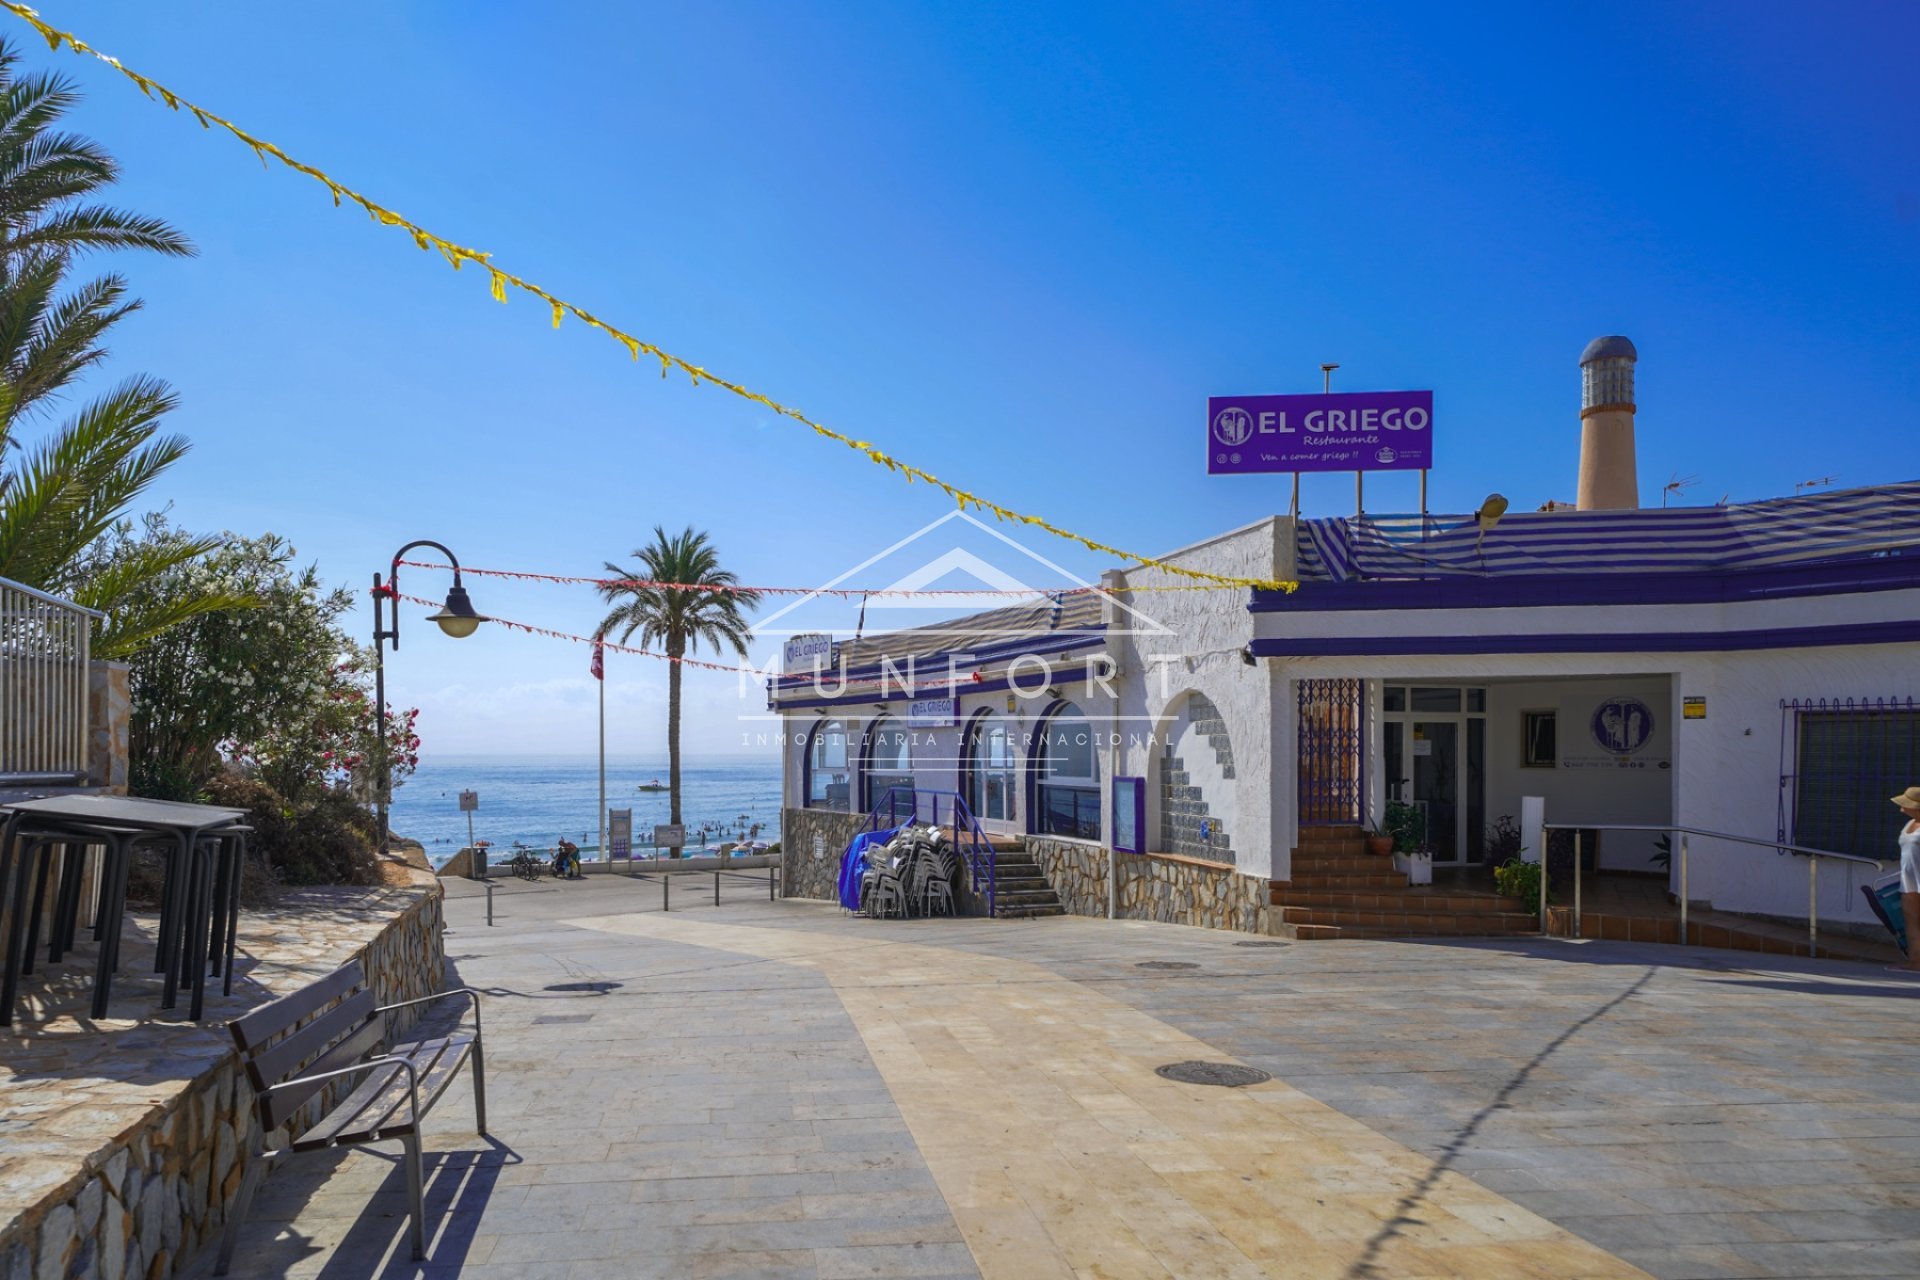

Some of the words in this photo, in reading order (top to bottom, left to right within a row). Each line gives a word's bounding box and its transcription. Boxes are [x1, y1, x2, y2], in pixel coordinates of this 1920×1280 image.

[1259, 411, 1296, 433] EL
[1304, 407, 1428, 432] GRIEGO
[1303, 435, 1380, 446] Restaurante
[1260, 453, 1278, 461] Ven
[1322, 451, 1349, 461] griego
[794, 645, 802, 657] EL
[803, 641, 829, 655] GRIEGO
